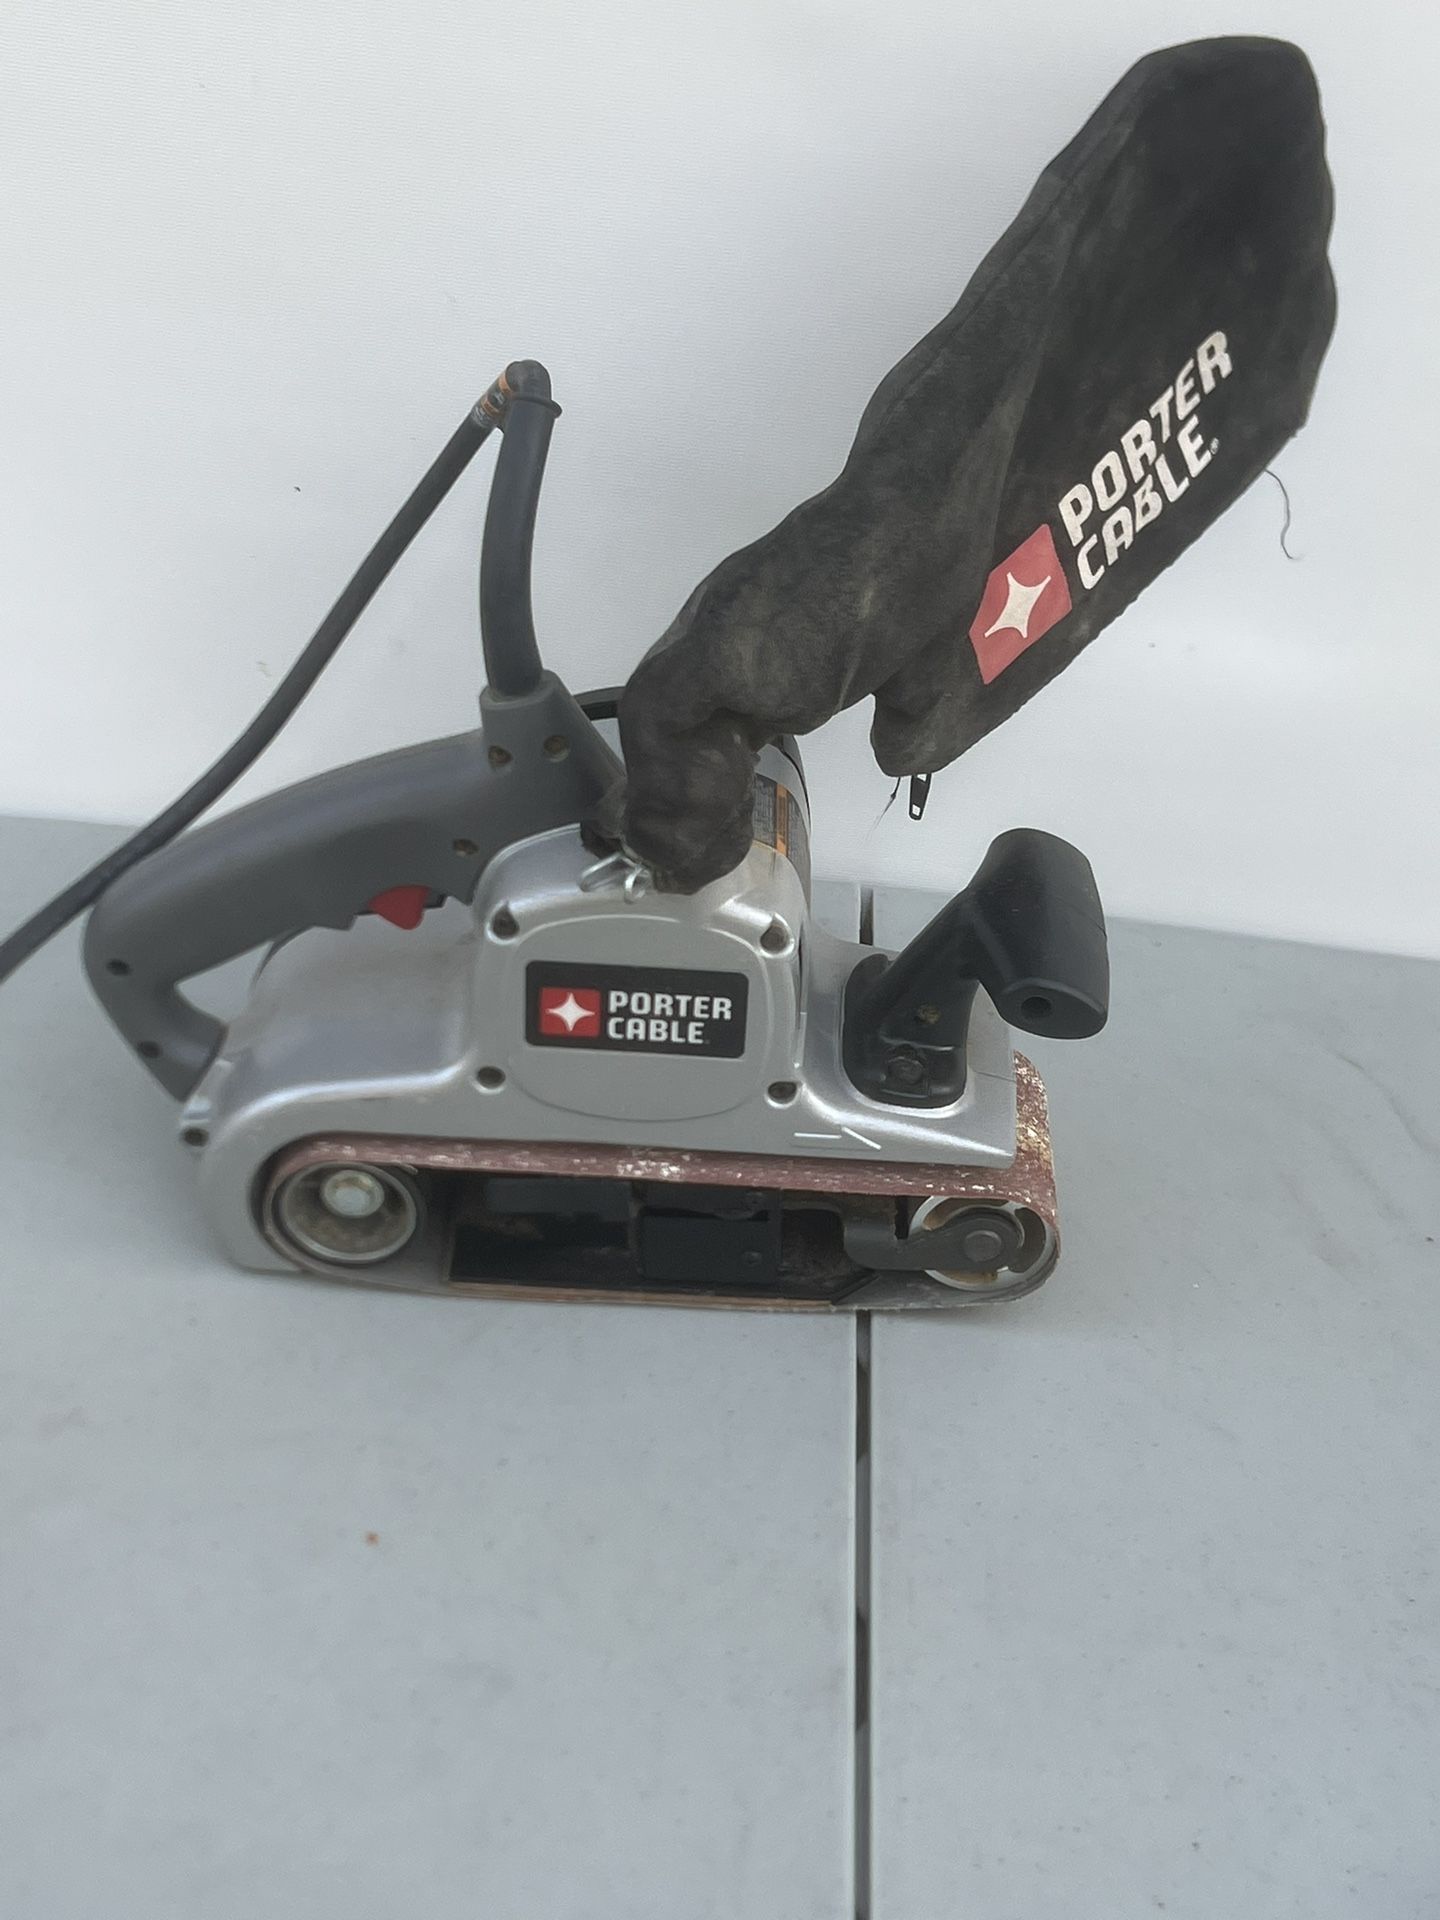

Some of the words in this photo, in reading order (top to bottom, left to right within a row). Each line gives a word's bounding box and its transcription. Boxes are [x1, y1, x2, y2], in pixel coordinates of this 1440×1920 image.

[1058, 330, 1233, 547] PORTER
[1077, 415, 1213, 590] CABLE
[607, 1017, 705, 1044] CABLE
[608, 990, 732, 1020] PORTER
